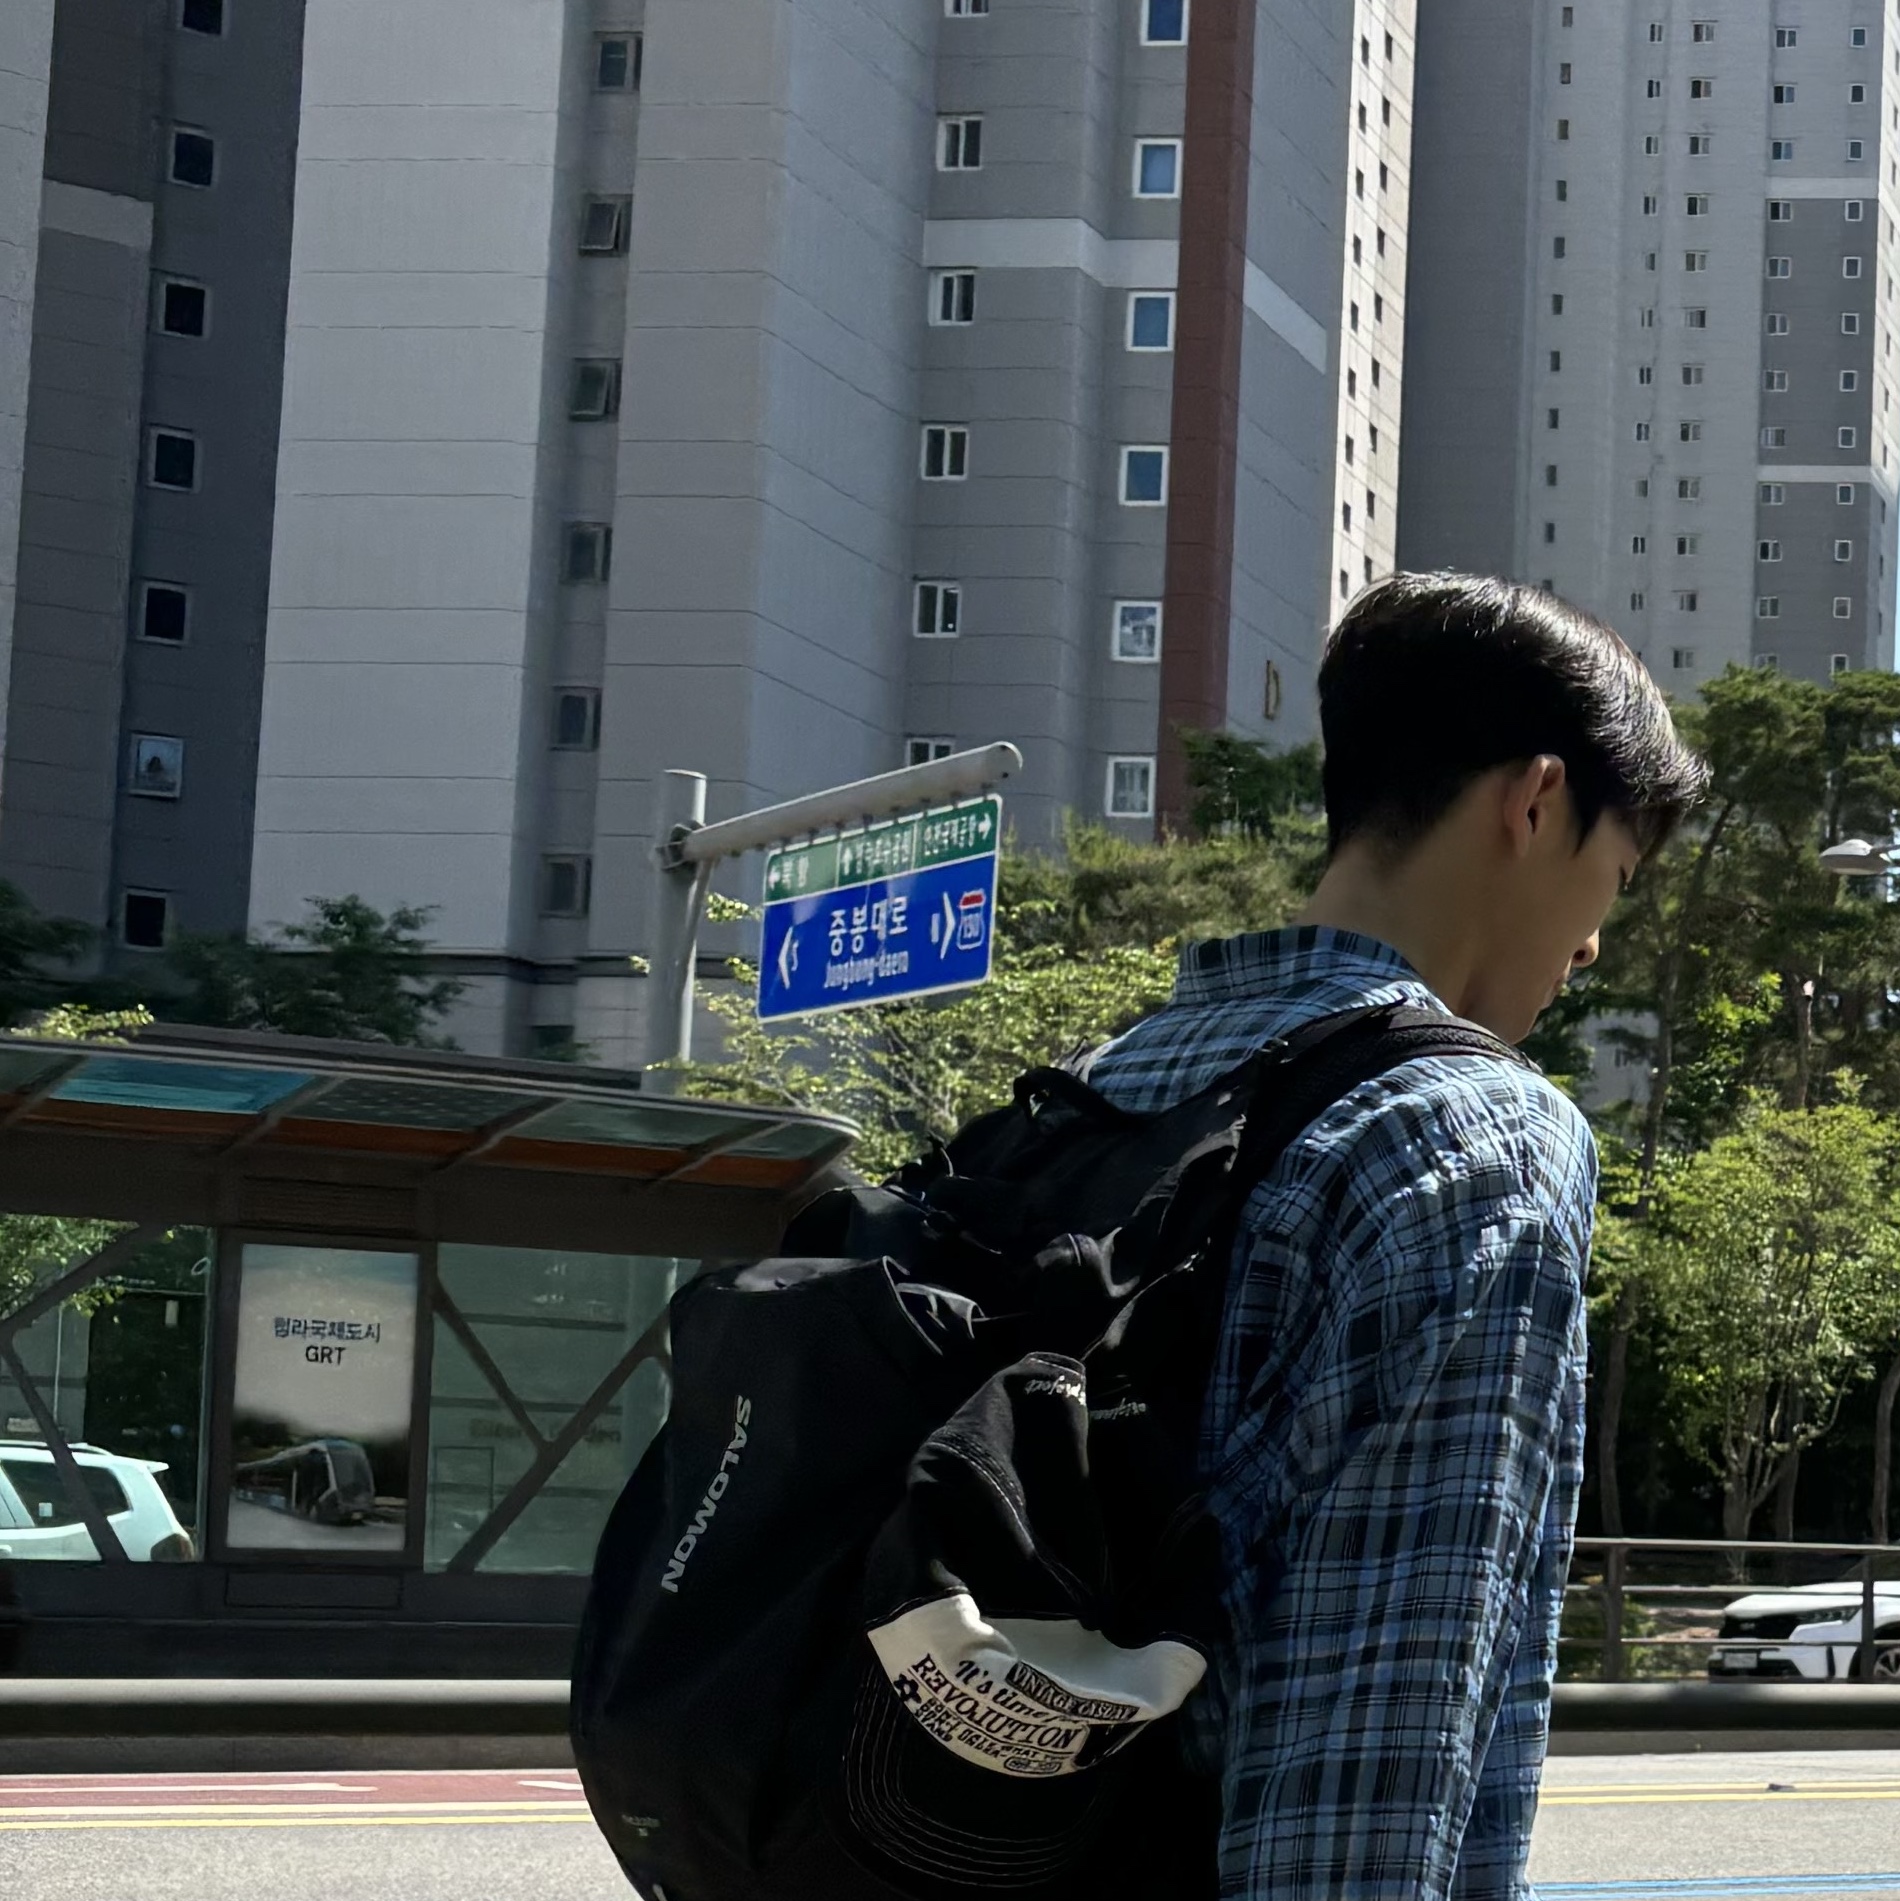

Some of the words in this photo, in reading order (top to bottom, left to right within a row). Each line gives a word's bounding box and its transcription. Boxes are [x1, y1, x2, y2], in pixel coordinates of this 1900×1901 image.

[828, 896, 909, 957] 중봉대로
[305, 1345, 347, 1365] GRT
[661, 1395, 751, 1593] SALOMON
